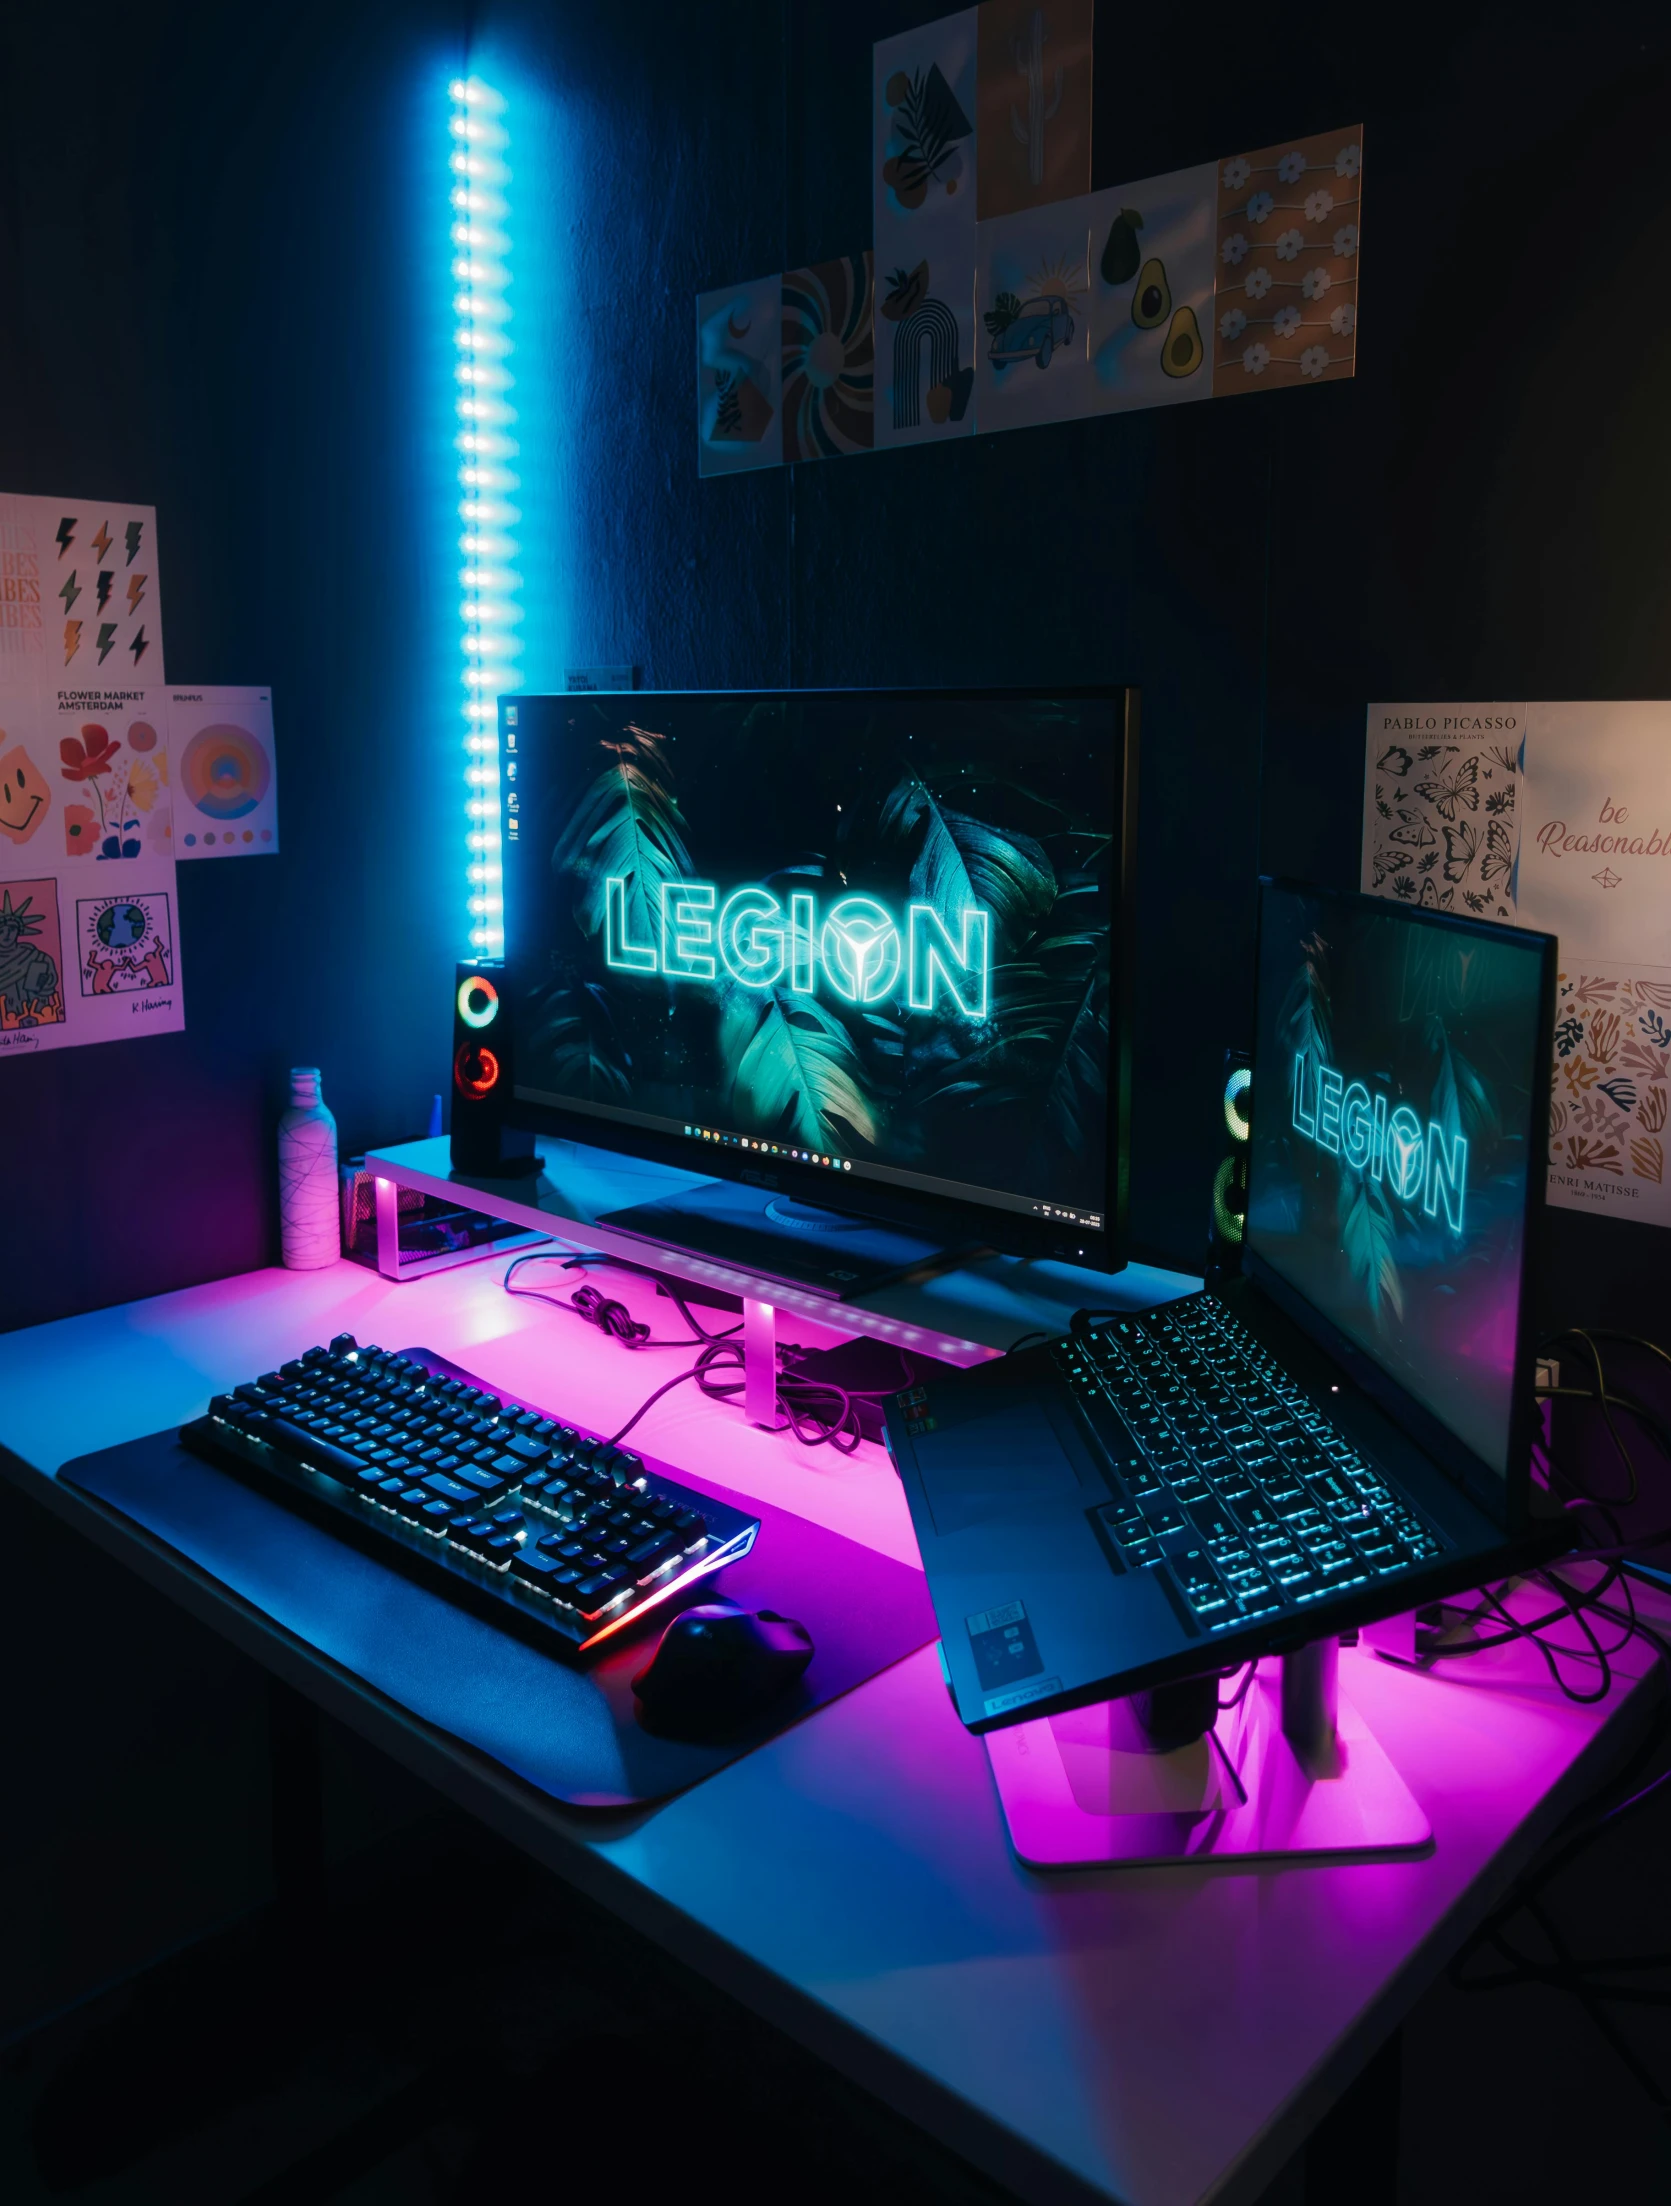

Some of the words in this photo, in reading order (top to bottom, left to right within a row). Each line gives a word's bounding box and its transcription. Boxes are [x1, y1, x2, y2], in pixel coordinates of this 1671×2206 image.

[57, 692, 101, 700] FLOWER
[104, 692, 145, 701] MARKET
[58, 701, 123, 711] AMSTERDAM
[1384, 717, 1436, 730] PABLO
[1443, 717, 1516, 730] PICASSO
[1598, 797, 1629, 824] be
[1536, 821, 1671, 858] Reasonabl
[604, 877, 989, 1018] LEGION
[1293, 1054, 1467, 1233] LEGION
[1549, 1174, 1579, 1188] ENRI
[1583, 1180, 1639, 1198] MATISSE
[1149, 1416, 1160, 1424] N
[1169, 1385, 1180, 1393] G
[1178, 1398, 1189, 1406] H
[1198, 1426, 1210, 1434] K
[991, 1683, 1054, 1710] Lenovo
